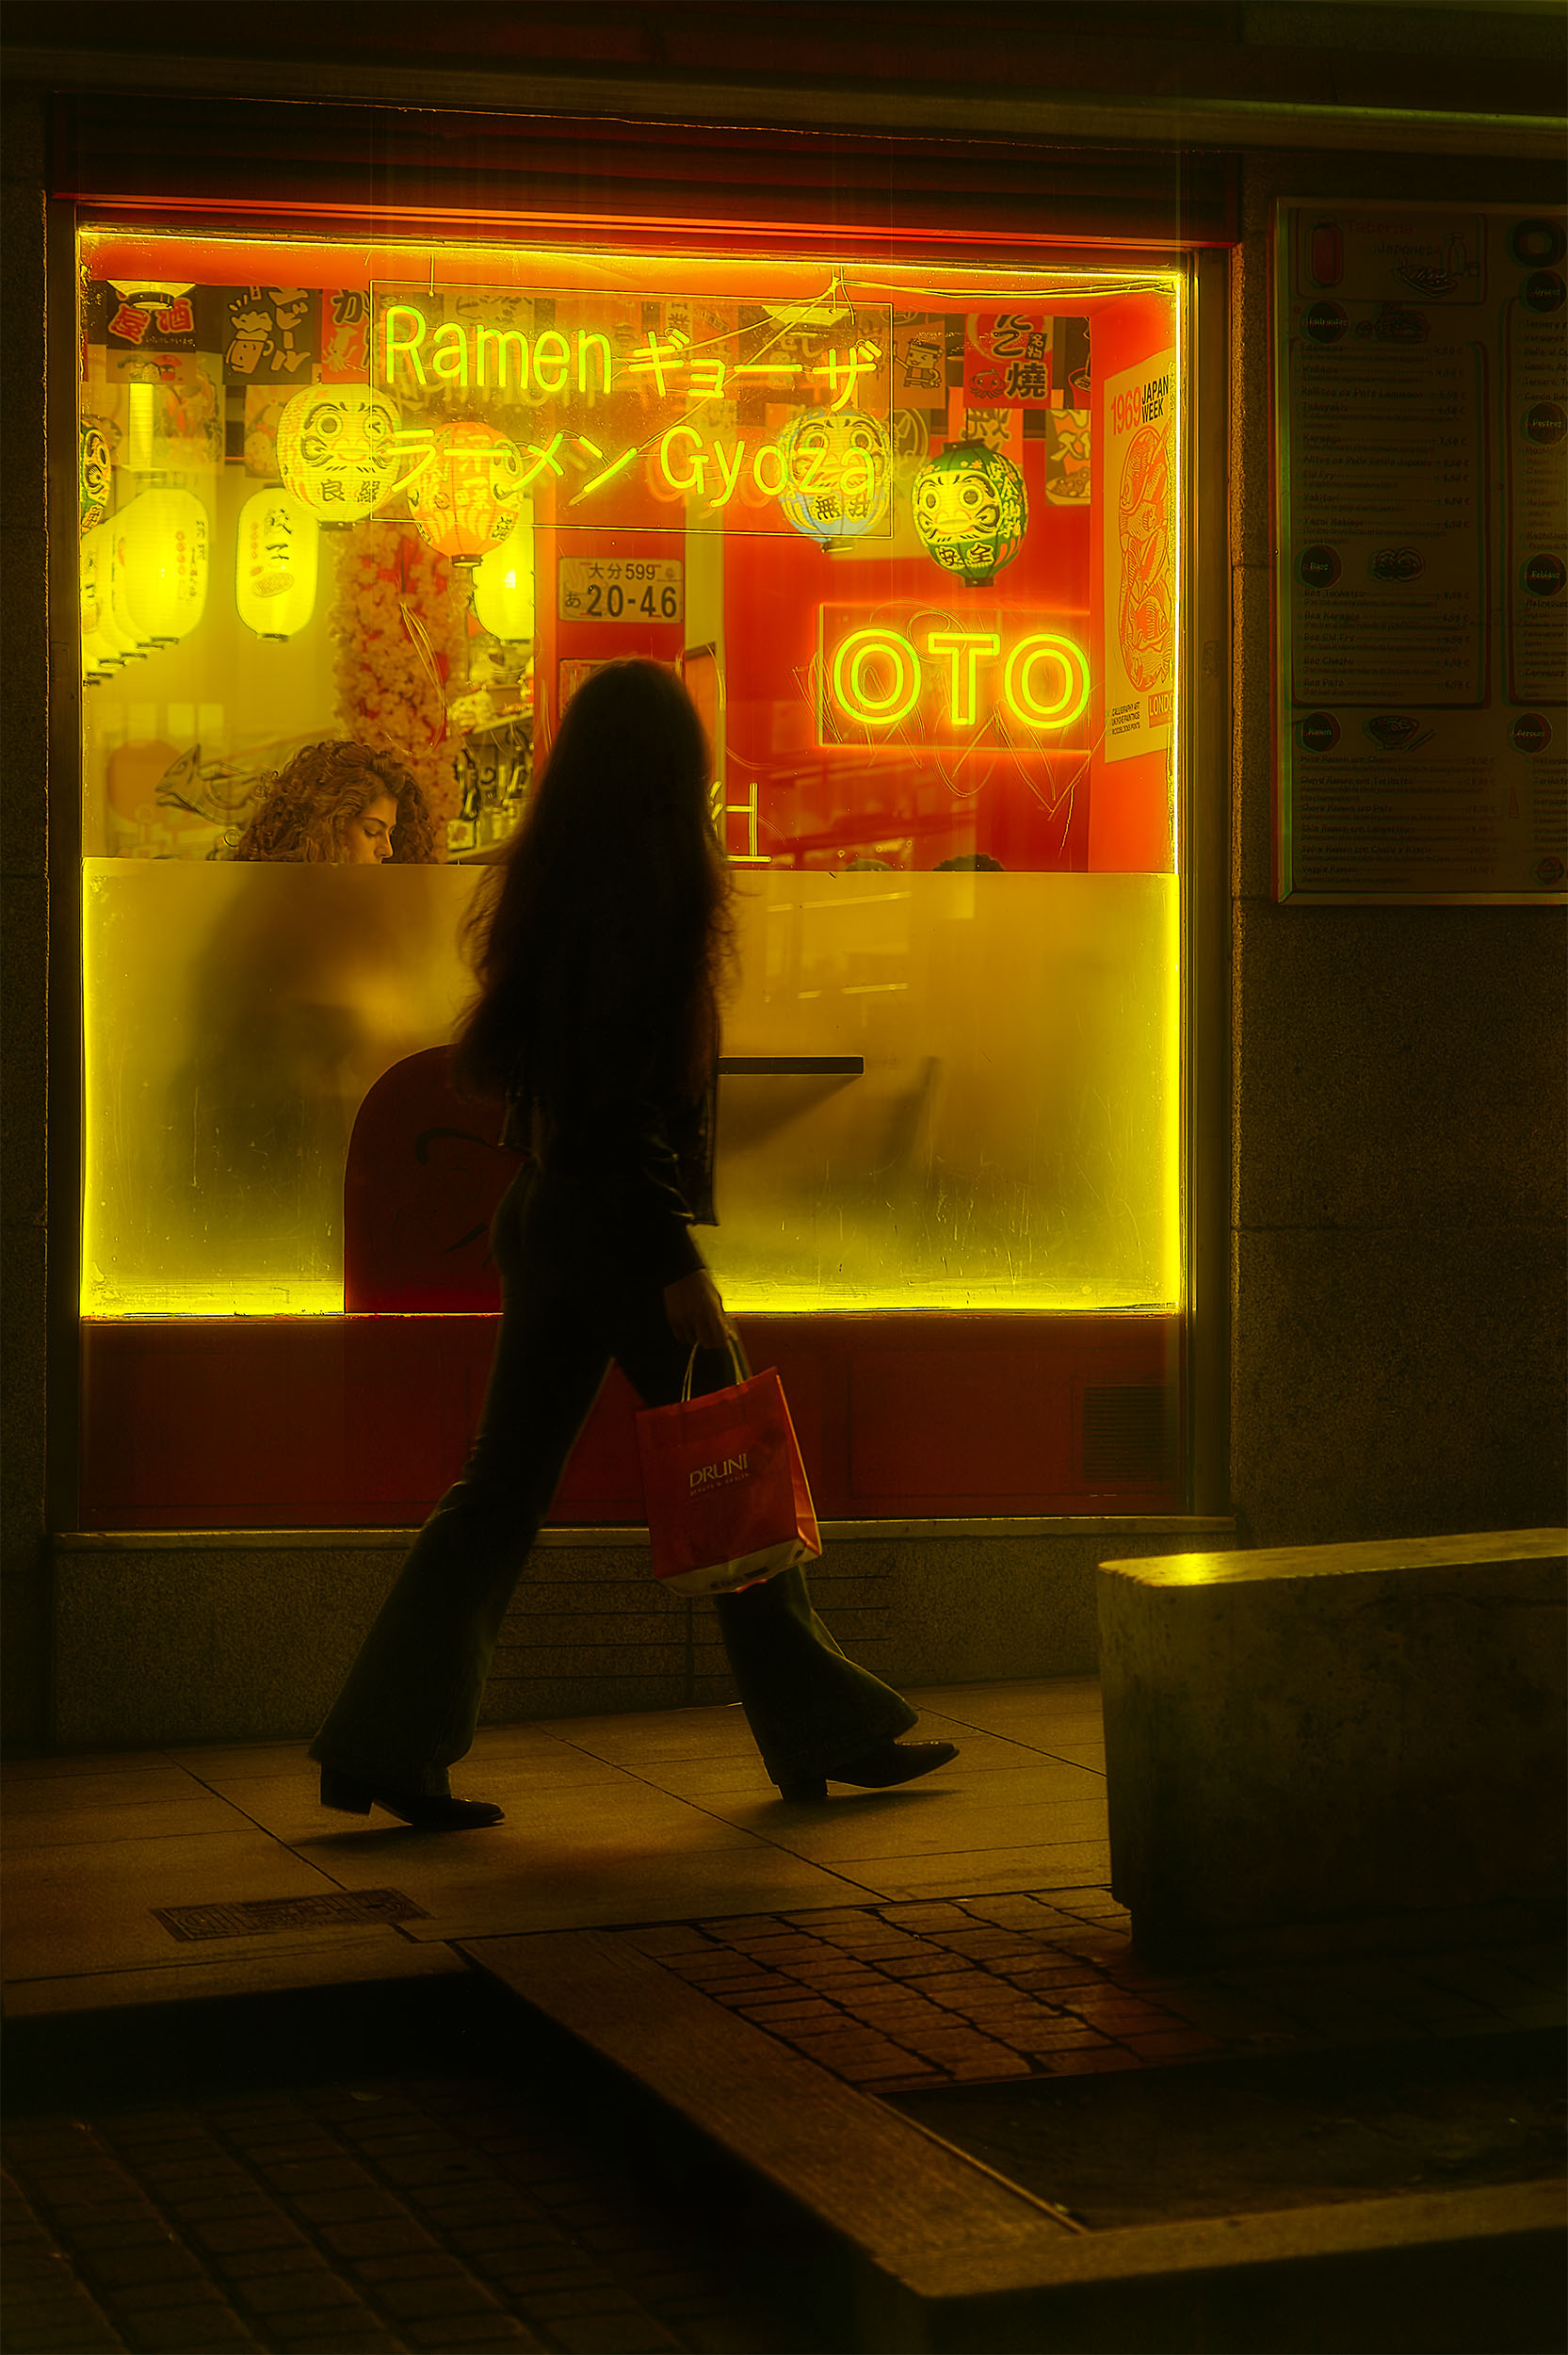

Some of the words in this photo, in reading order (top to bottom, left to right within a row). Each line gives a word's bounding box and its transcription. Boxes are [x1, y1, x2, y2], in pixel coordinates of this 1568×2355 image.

[384, 304, 612, 395] Ramen
[627, 327, 882, 413] ギョーザ
[1141, 374, 1170, 405] JAPAN
[1111, 386, 1141, 436] 1969
[1141, 398, 1164, 424] WEEK
[385, 429, 637, 506] ラーメン
[660, 425, 876, 509] Gyoza
[625, 563, 655, 581] 599
[938, 544, 993, 567] 安全
[565, 591, 581, 609] あ
[587, 584, 677, 619] 20-46
[833, 628, 1091, 729] OTO
[689, 1454, 748, 1488] DRUNI
